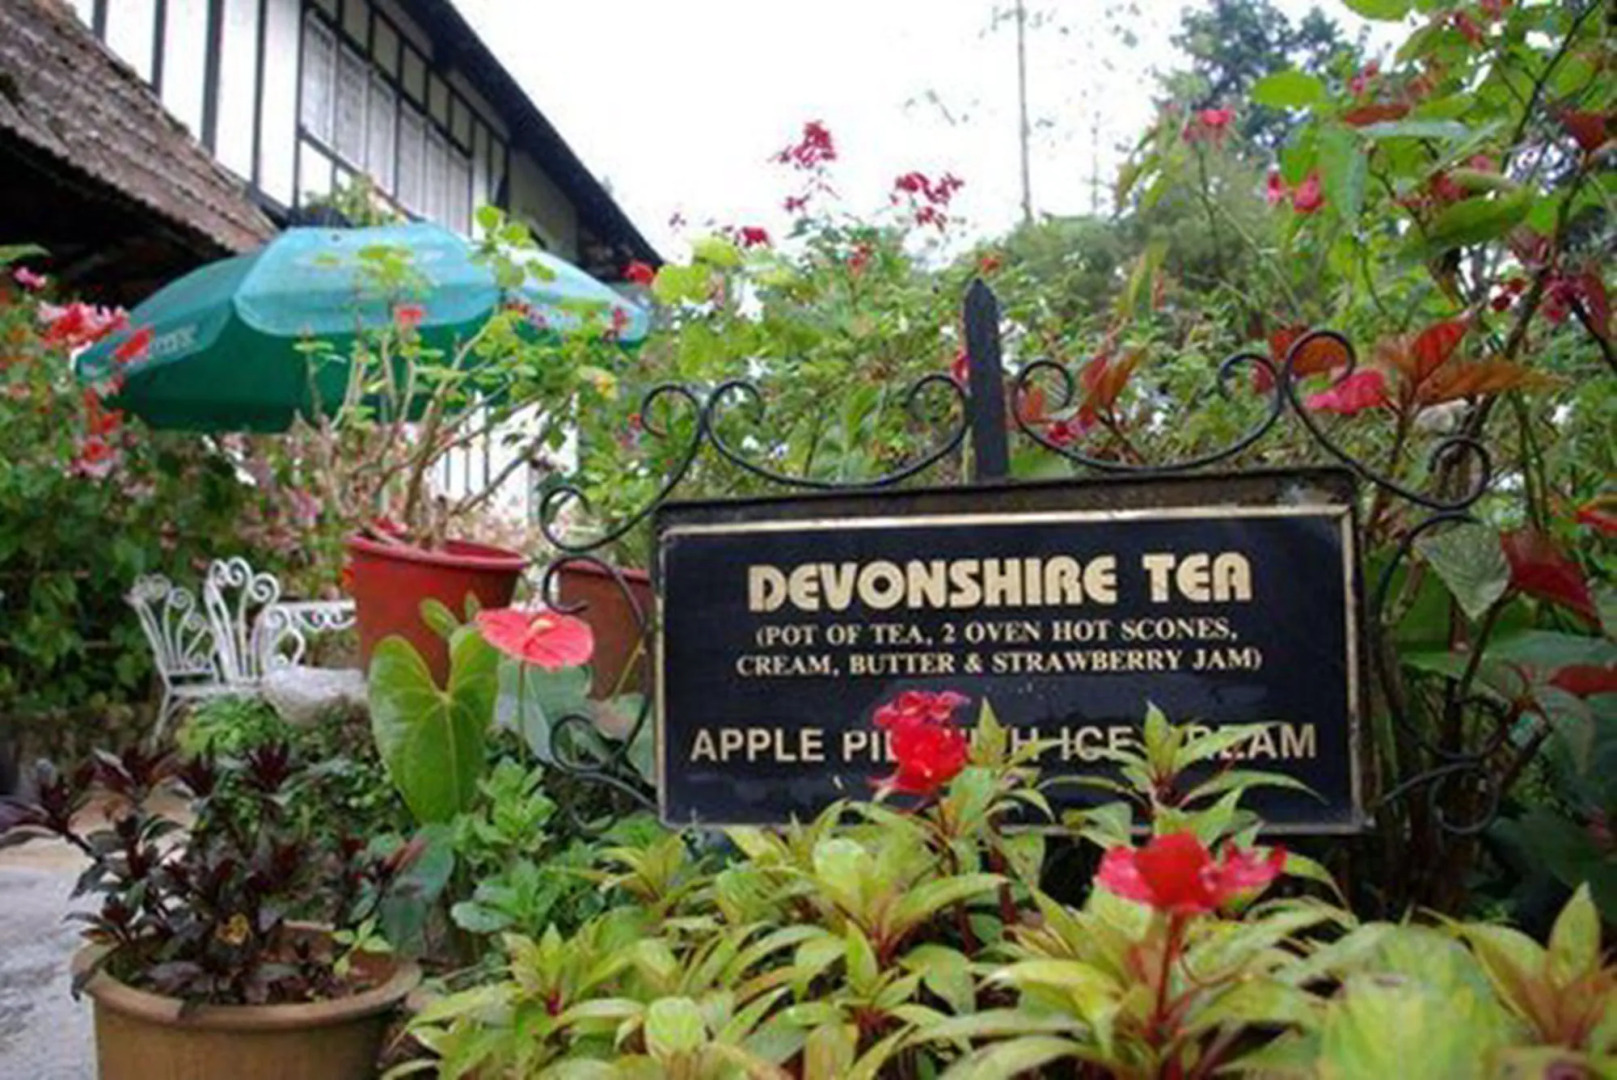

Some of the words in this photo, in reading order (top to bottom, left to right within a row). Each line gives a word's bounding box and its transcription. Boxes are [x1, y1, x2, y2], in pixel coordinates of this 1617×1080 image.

[747, 555, 1118, 612] DEVONSHIRE
[1142, 552, 1252, 603] TEA
[755, 623, 819, 648] (POT
[826, 623, 862, 645] OF
[870, 622, 933, 647] TEA,
[942, 622, 956, 644] 2
[964, 620, 1041, 644] OVEN
[1052, 619, 1112, 642] HOT
[1121, 616, 1238, 642] SCONES,
[735, 653, 840, 678] CREAM,
[849, 651, 955, 675] BUTTER
[963, 652, 983, 674] &
[991, 649, 1183, 674] STRAWBERRY
[1192, 646, 1263, 671] JAM)
[690, 727, 825, 763] APPLE
[1060, 725, 1134, 763] ICE
